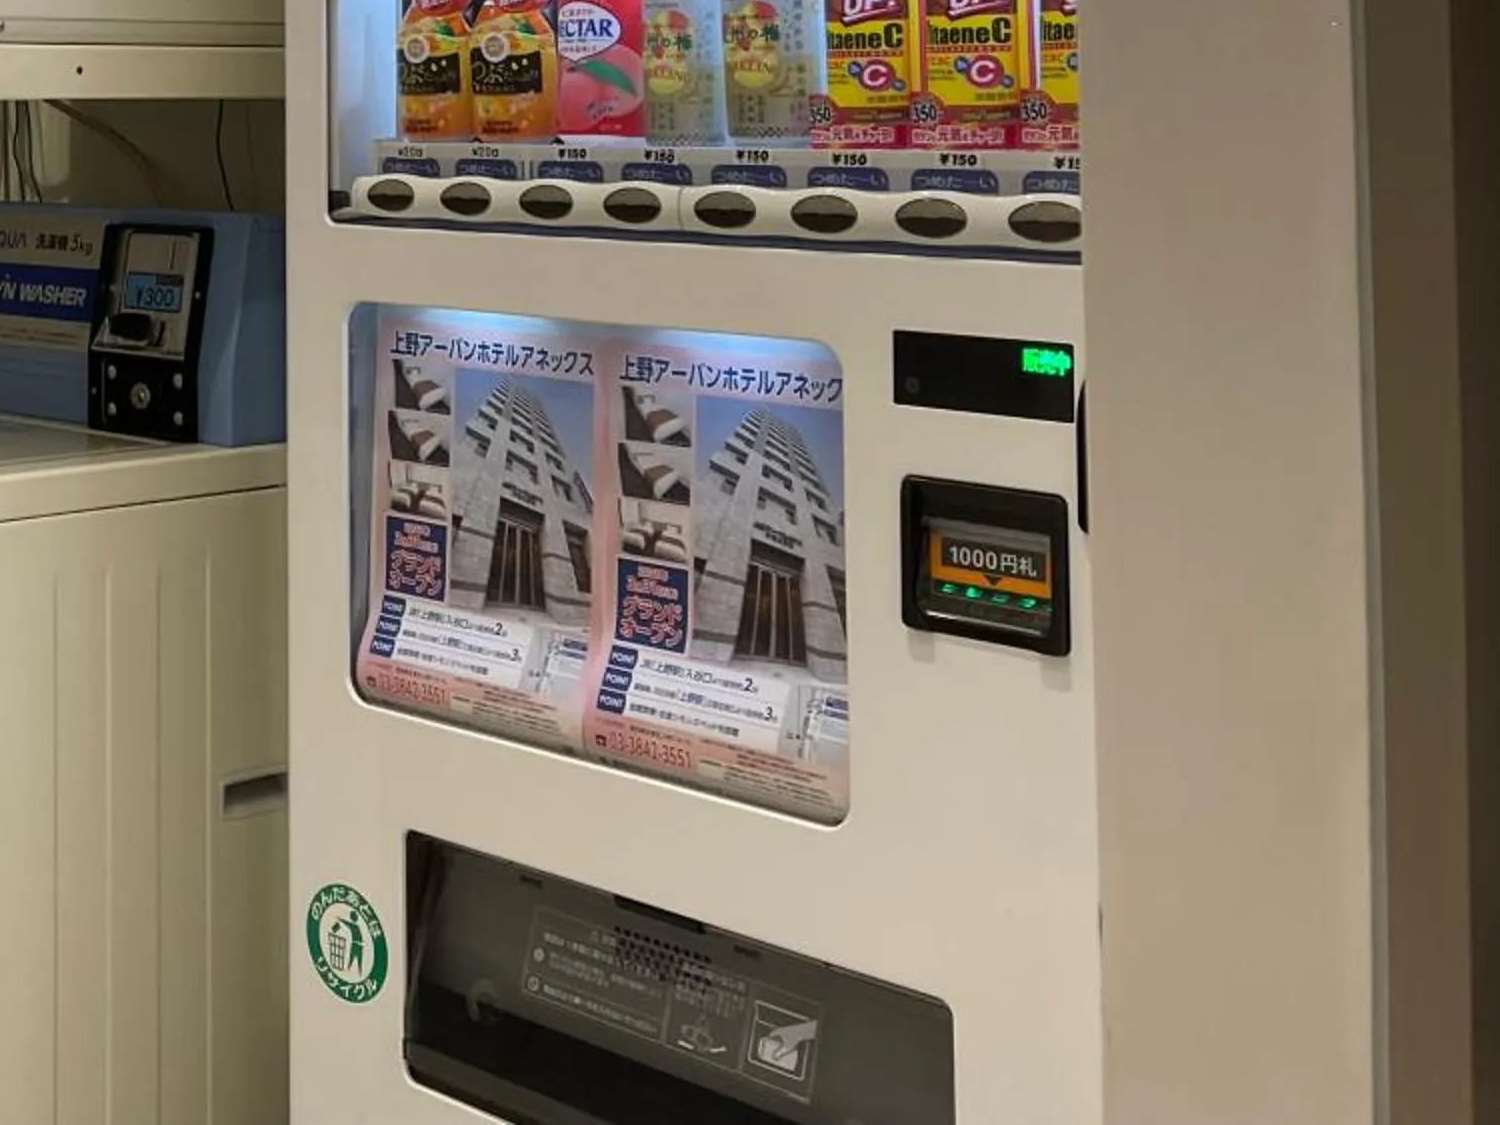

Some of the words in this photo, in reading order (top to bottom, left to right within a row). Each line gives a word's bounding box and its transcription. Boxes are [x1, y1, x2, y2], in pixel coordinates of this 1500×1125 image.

[863, 63, 888, 87] C
[970, 59, 996, 83] C
[809, 106, 831, 123] 350
[913, 103, 937, 122] 350
[1021, 102, 1047, 121] 350
[558, 148, 587, 159] ¥150
[644, 150, 675, 163] ¥150
[736, 150, 769, 163] ¥150
[832, 153, 867, 166] ¥150
[940, 153, 978, 166] ¥150
[18, 280, 88, 308] WASHER
[949, 546, 1037, 577] 1000円札
[611, 652, 635, 664] POINT
[606, 673, 630, 686] POINT
[600, 695, 624, 708] POINT
[311, 886, 381, 938] のんだあとは
[316, 955, 378, 1000] リサイクル
